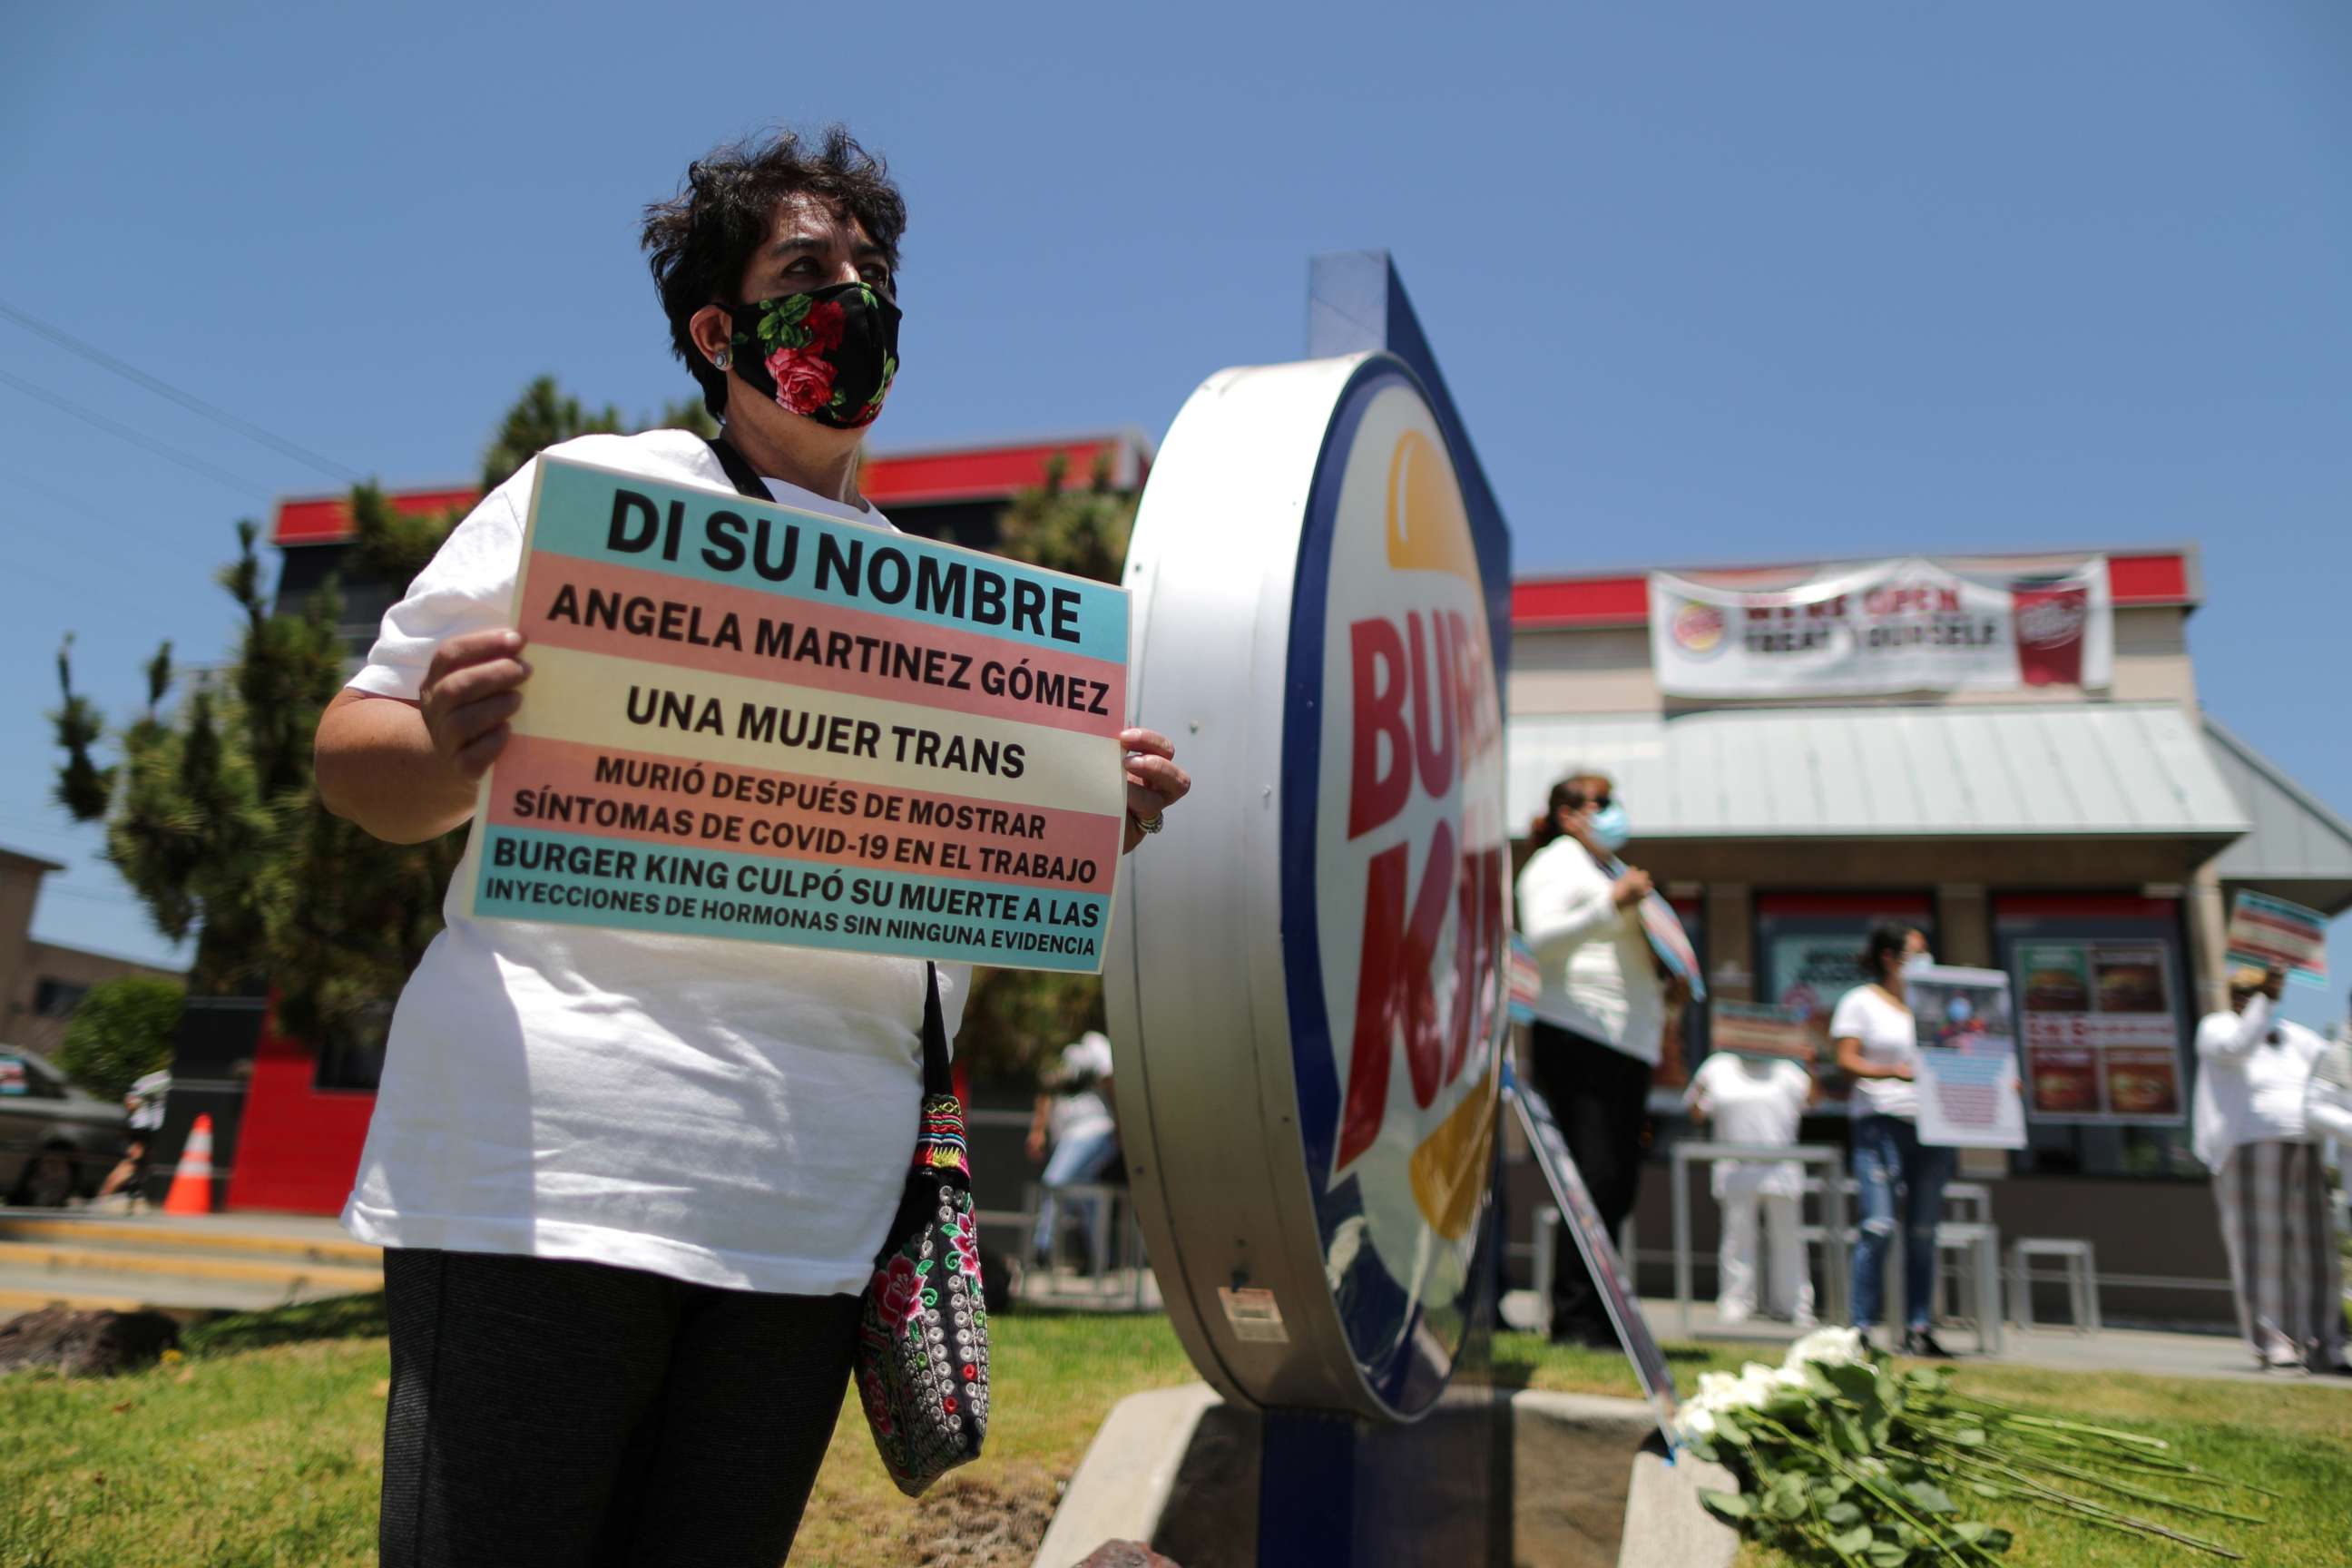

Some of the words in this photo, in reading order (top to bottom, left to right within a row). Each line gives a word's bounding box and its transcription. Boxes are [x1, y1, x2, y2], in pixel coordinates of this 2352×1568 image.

[606, 488, 685, 562] DI
[701, 510, 800, 583] SU
[814, 532, 1082, 644] NOMBRE
[547, 583, 742, 652] ANGELA
[754, 618, 974, 691] MARTINEZ
[980, 658, 1110, 716] GÓMEZ
[626, 685, 724, 736] UNA
[737, 702, 881, 759] MUJER
[891, 725, 1025, 779] TRANS
[514, 784, 693, 837] SÍNTOMAS
[701, 812, 743, 842] DE
[750, 819, 888, 860] COVID-19
[894, 837, 935, 866] EN
[939, 842, 971, 870] EL
[979, 847, 1097, 884] TRABAJO
[595, 756, 705, 795] MURIÓ
[711, 771, 858, 816] DESPUÉS
[863, 792, 904, 822] DE
[907, 799, 1046, 840] MOSTRAR
[485, 877, 660, 915] INYECCIONES
[665, 896, 697, 918] DE
[701, 899, 839, 932] HORMONAS
[843, 914, 882, 936] SIN
[886, 918, 986, 947] NINGUNA
[990, 929, 1094, 956] EVIDENCIA
[494, 837, 637, 880] BURGER
[644, 854, 729, 889] KING
[737, 865, 844, 902] CULPÓ
[850, 877, 894, 907] SU
[898, 883, 1020, 921] MUERTE
[1023, 897, 1042, 924] A
[1048, 899, 1100, 928] LAS
